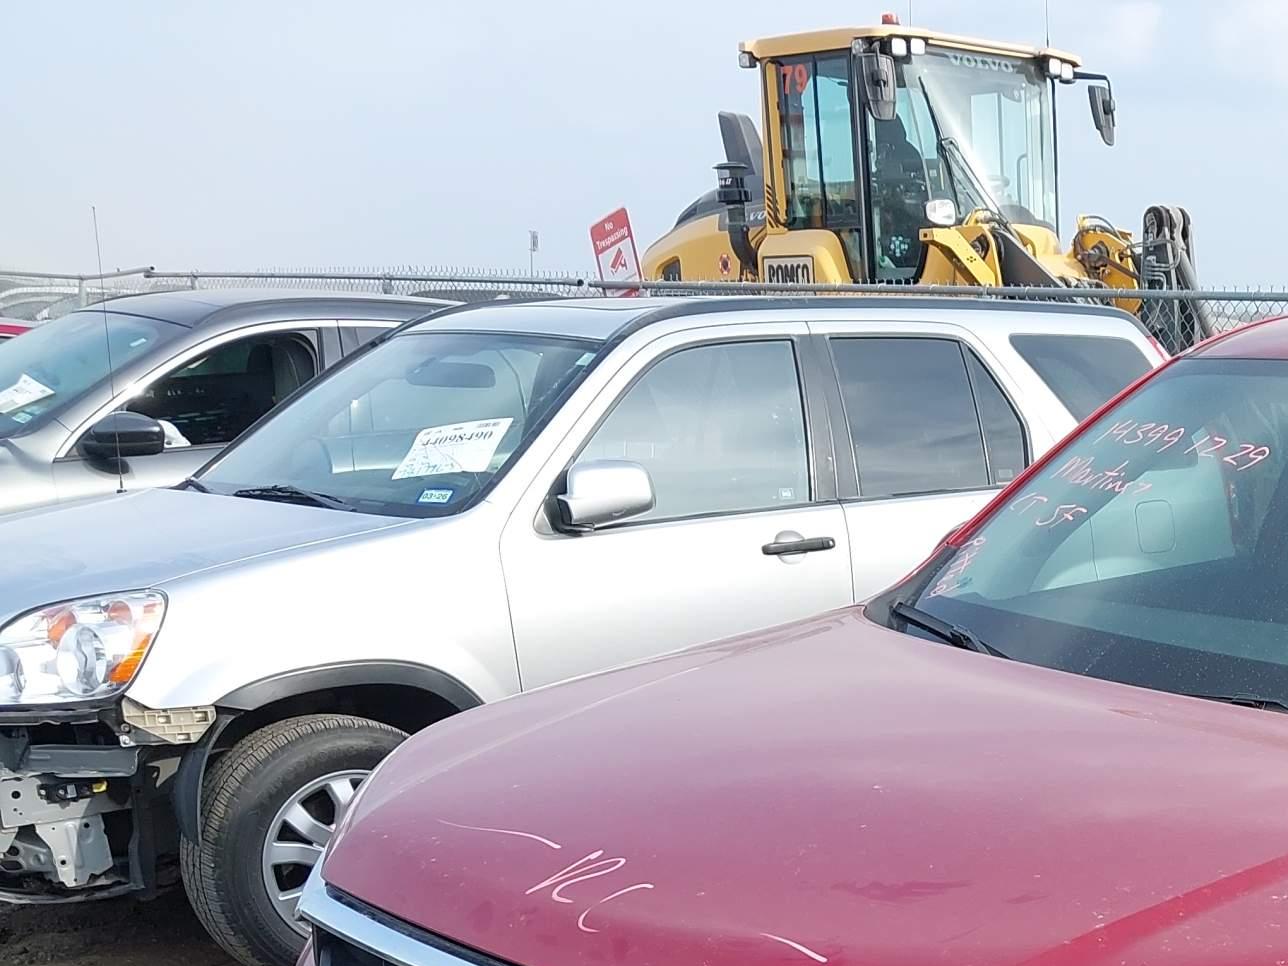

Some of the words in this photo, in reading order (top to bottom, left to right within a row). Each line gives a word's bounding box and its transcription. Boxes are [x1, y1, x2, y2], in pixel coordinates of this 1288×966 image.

[949, 53, 1014, 73] VOLVO
[781, 65, 807, 95] 79
[604, 221, 614, 233] No
[596, 226, 629, 251] Trespassing
[767, 263, 811, 284] ROMCO
